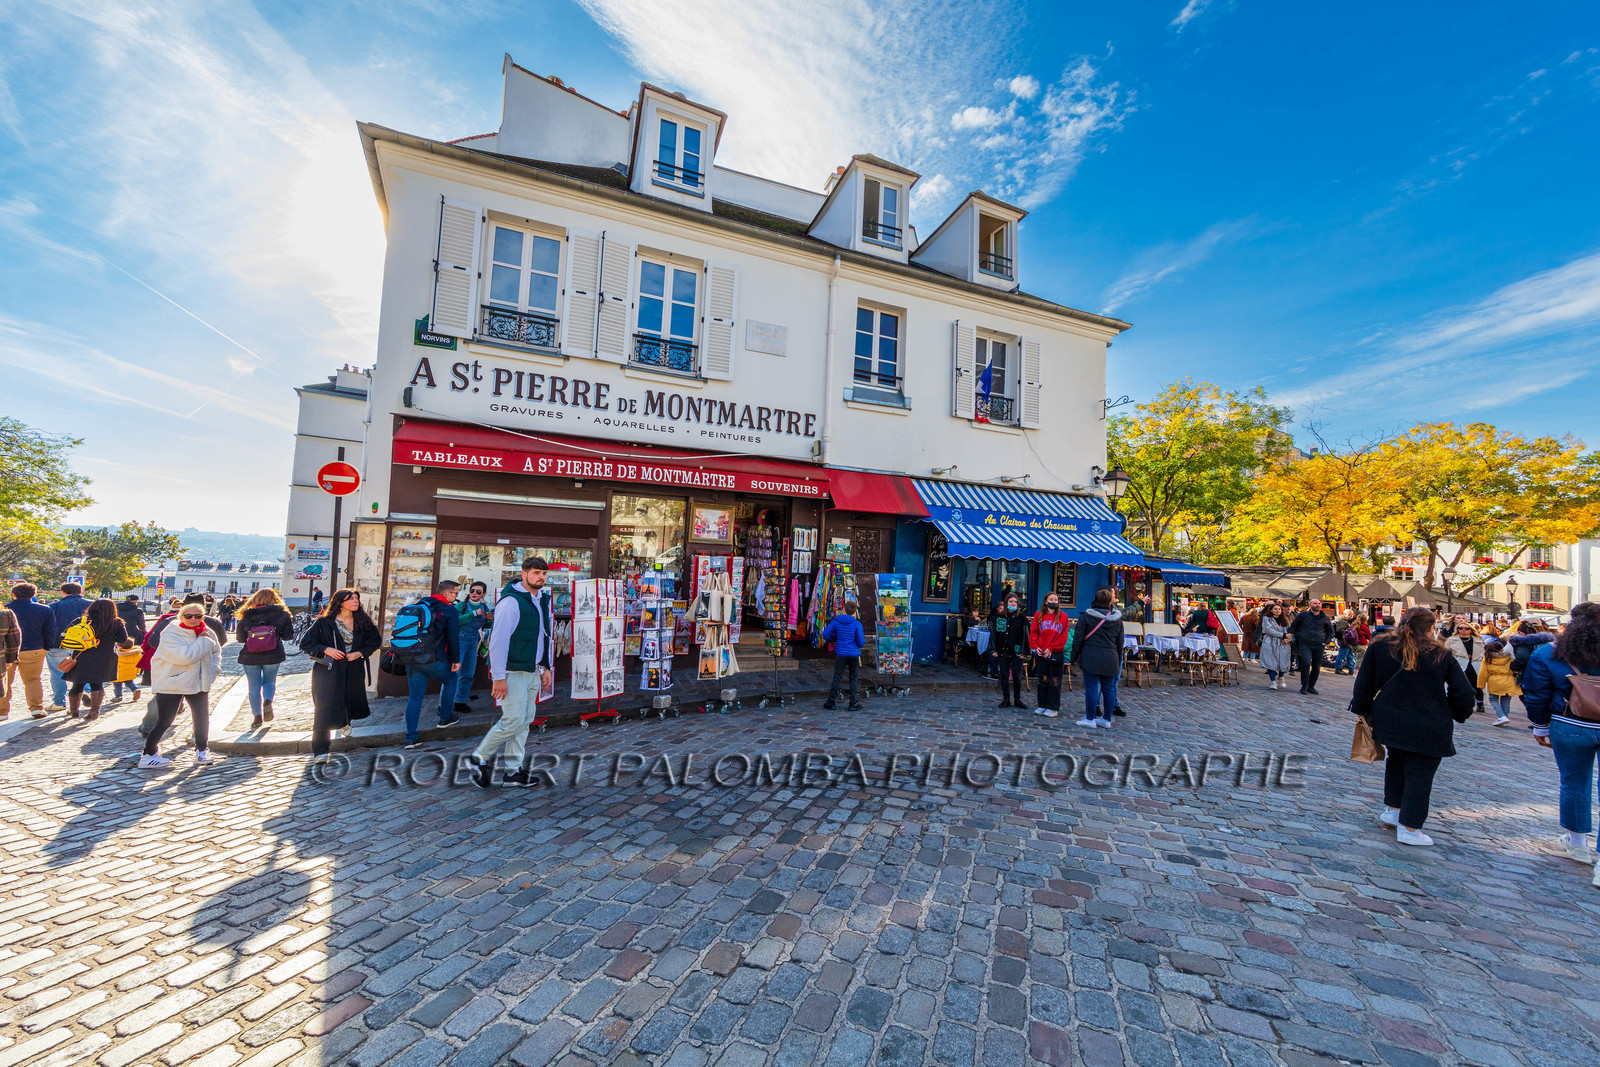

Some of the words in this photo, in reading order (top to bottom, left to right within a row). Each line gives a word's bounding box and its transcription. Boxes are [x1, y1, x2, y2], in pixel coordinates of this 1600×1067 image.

[421, 333, 450, 344] NORVINS
[410, 357, 437, 388] A
[492, 367, 610, 411] PIERRE
[617, 397, 637, 414] DE
[643, 389, 816, 437] MONTMARTRE
[490, 403, 563, 419] GRAVURES
[593, 417, 675, 433] AQUARELLES
[700, 430, 762, 444] PEINTURES
[412, 450, 503, 467] TABLEAUX
[523, 457, 534, 472] A
[556, 459, 613, 477] PIERRE
[617, 463, 637, 479] DE
[641, 466, 735, 489] MONTMARTRE
[751, 480, 819, 495] SOUVENIRS
[984, 514, 997, 525] Au
[1000, 515, 1027, 528] Clairon
[1030, 518, 1042, 528] des
[1043, 519, 1077, 531] Chasseurs
